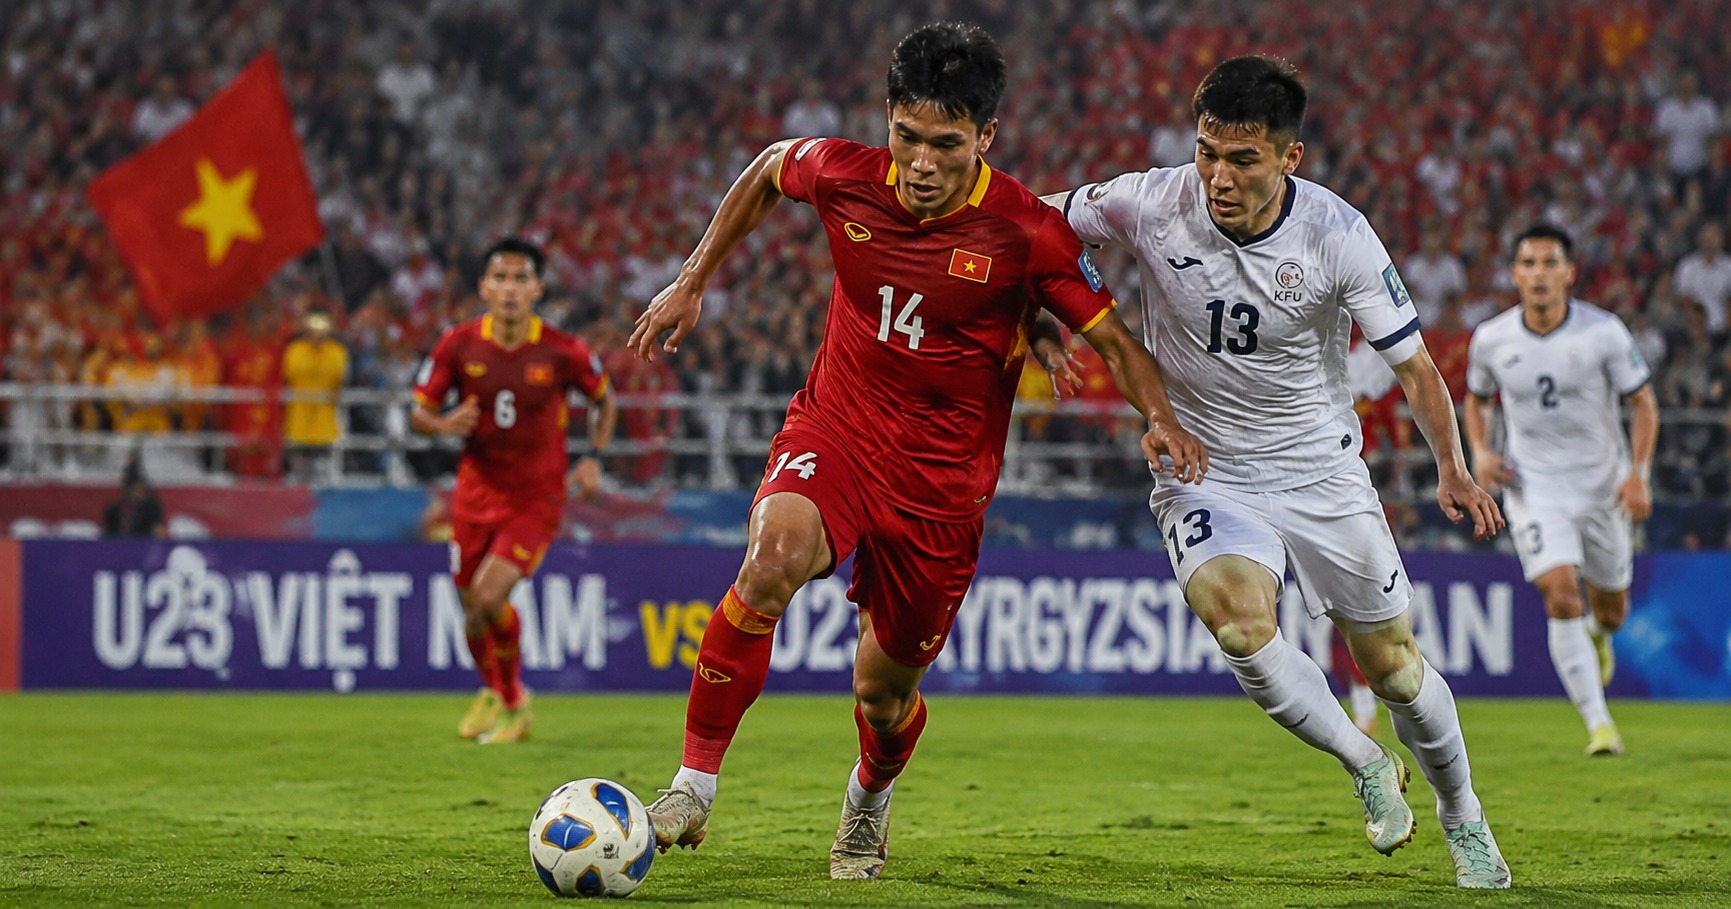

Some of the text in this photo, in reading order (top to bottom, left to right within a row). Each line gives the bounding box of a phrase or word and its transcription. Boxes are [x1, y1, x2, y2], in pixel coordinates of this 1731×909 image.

[877, 285, 925, 350] 14
[1274, 290, 1302, 302] KFU
[1205, 299, 1259, 355] 13
[494, 389, 517, 429] 6
[1537, 376, 1557, 408] 2
[768, 452, 818, 482] 14
[1168, 508, 1212, 567] 13
[93, 570, 233, 672] U23
[246, 549, 414, 693] VIỆT
[769, 576, 858, 673] U2
